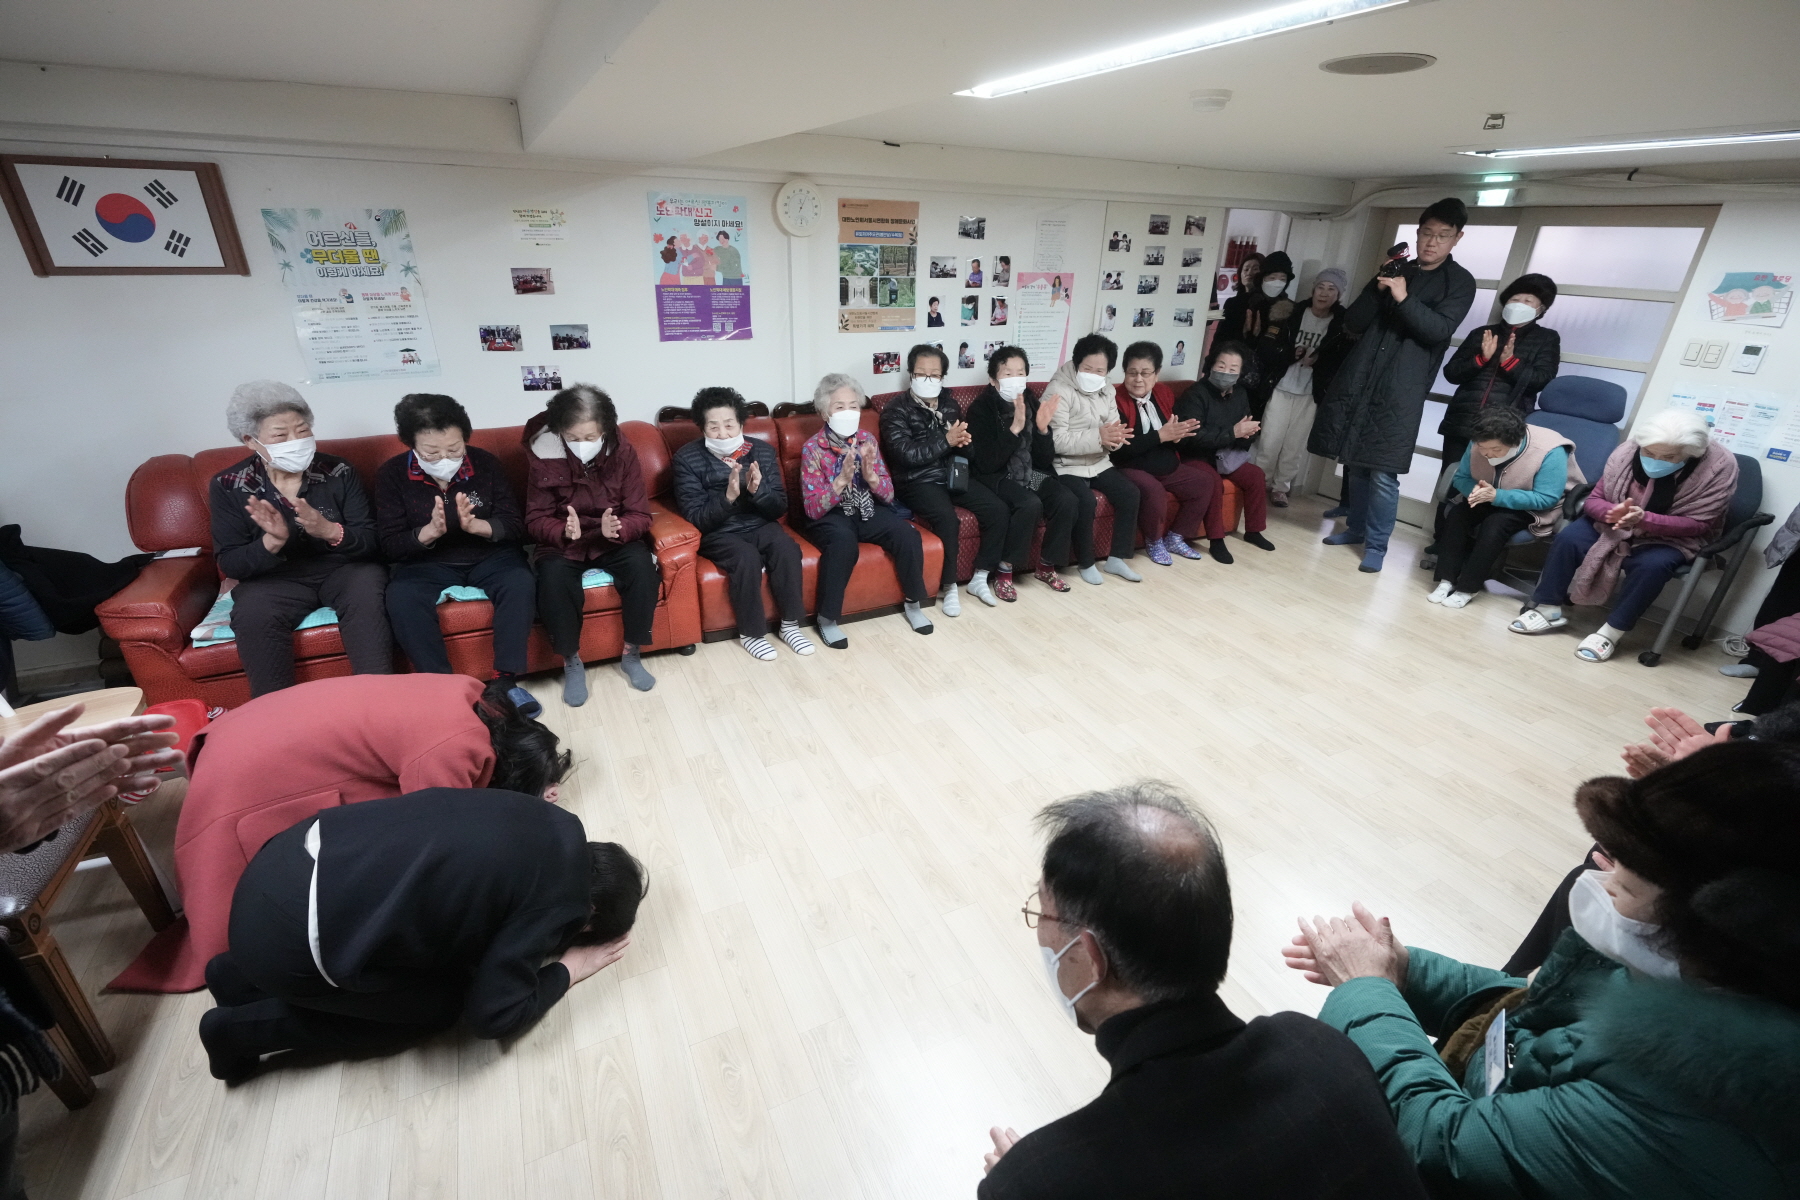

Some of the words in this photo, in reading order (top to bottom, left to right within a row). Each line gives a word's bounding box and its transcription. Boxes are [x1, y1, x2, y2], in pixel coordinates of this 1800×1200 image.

[670, 198, 683, 206] 우리는
[695, 207, 713, 218] 신고
[693, 218, 721, 227] 망설이지
[721, 219, 743, 228] 마세요!
[306, 230, 378, 248] 어르신들,
[310, 248, 361, 266] 무더울
[361, 248, 380, 265] 땐
[316, 266, 349, 278] 이렇게
[348, 265, 385, 277] 하세요!
